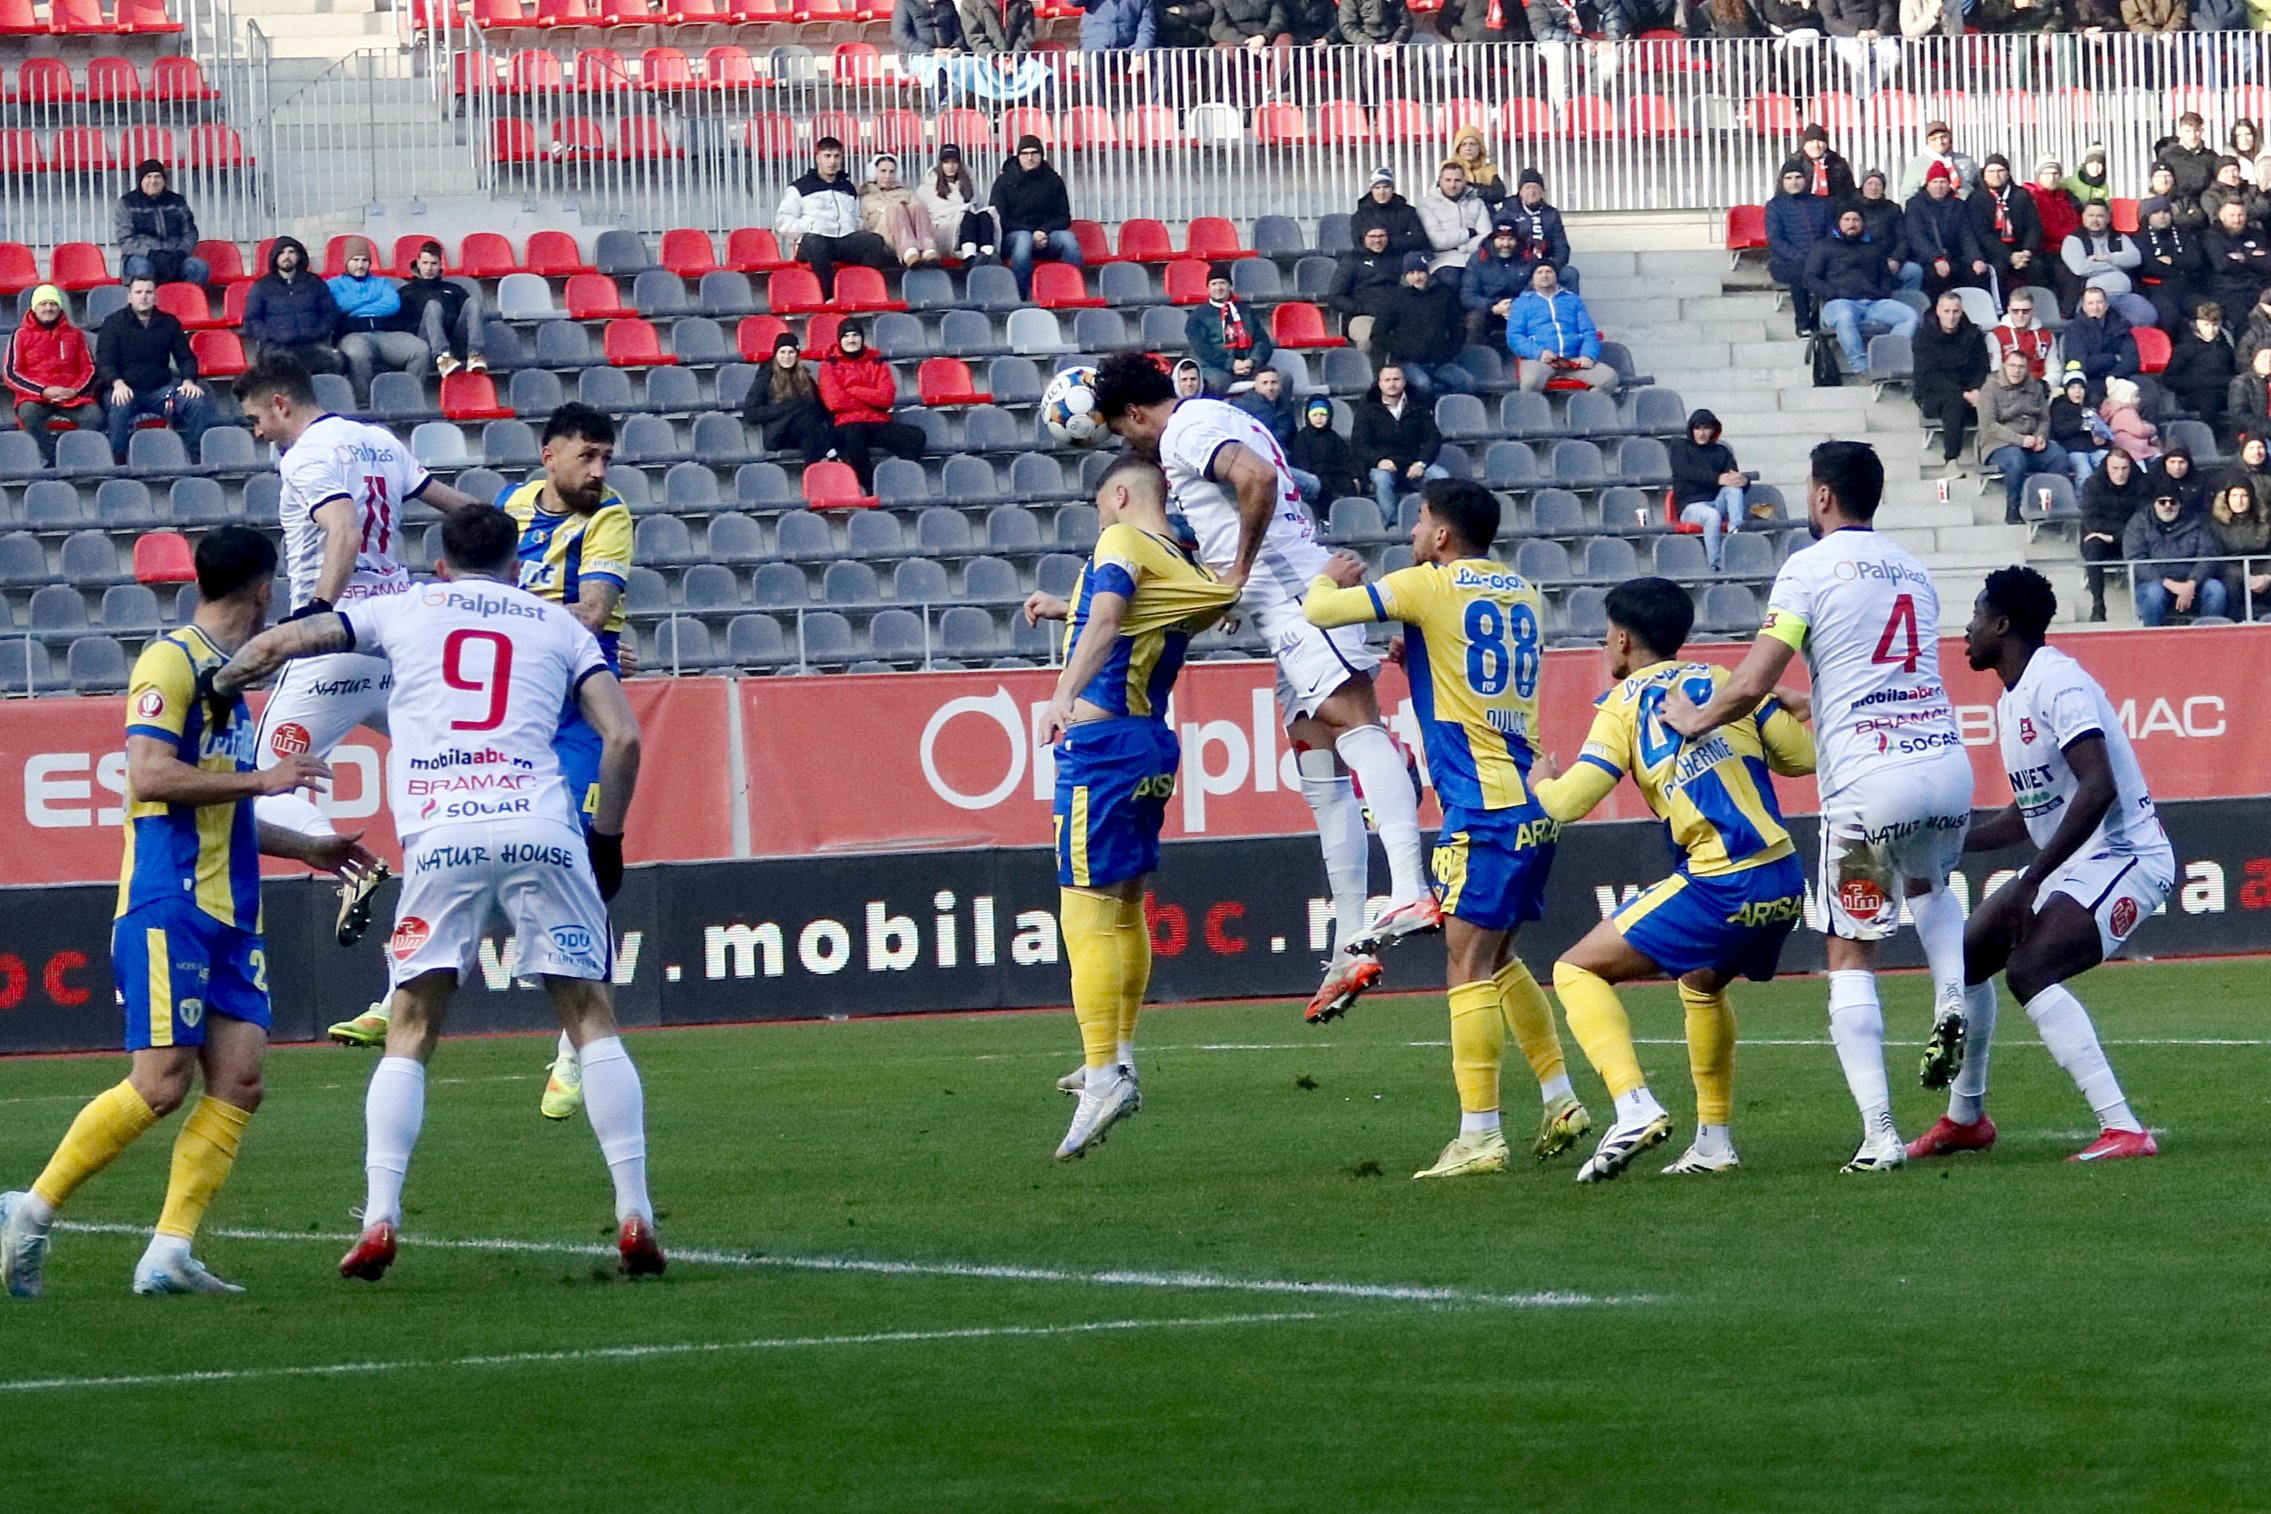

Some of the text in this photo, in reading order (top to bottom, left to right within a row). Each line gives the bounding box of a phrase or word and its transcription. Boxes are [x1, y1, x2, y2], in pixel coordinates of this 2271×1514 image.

[359, 475, 391, 554] 11
[341, 580, 412, 599] BRAMA
[447, 593, 547, 622] Palplast
[1464, 599, 1539, 699] 88
[1871, 594, 1923, 674] 4
[308, 678, 372, 696] NATUR
[442, 628, 514, 732] 9
[415, 844, 574, 875] NATUR HOUSE
[1843, 884, 1880, 911] ifm
